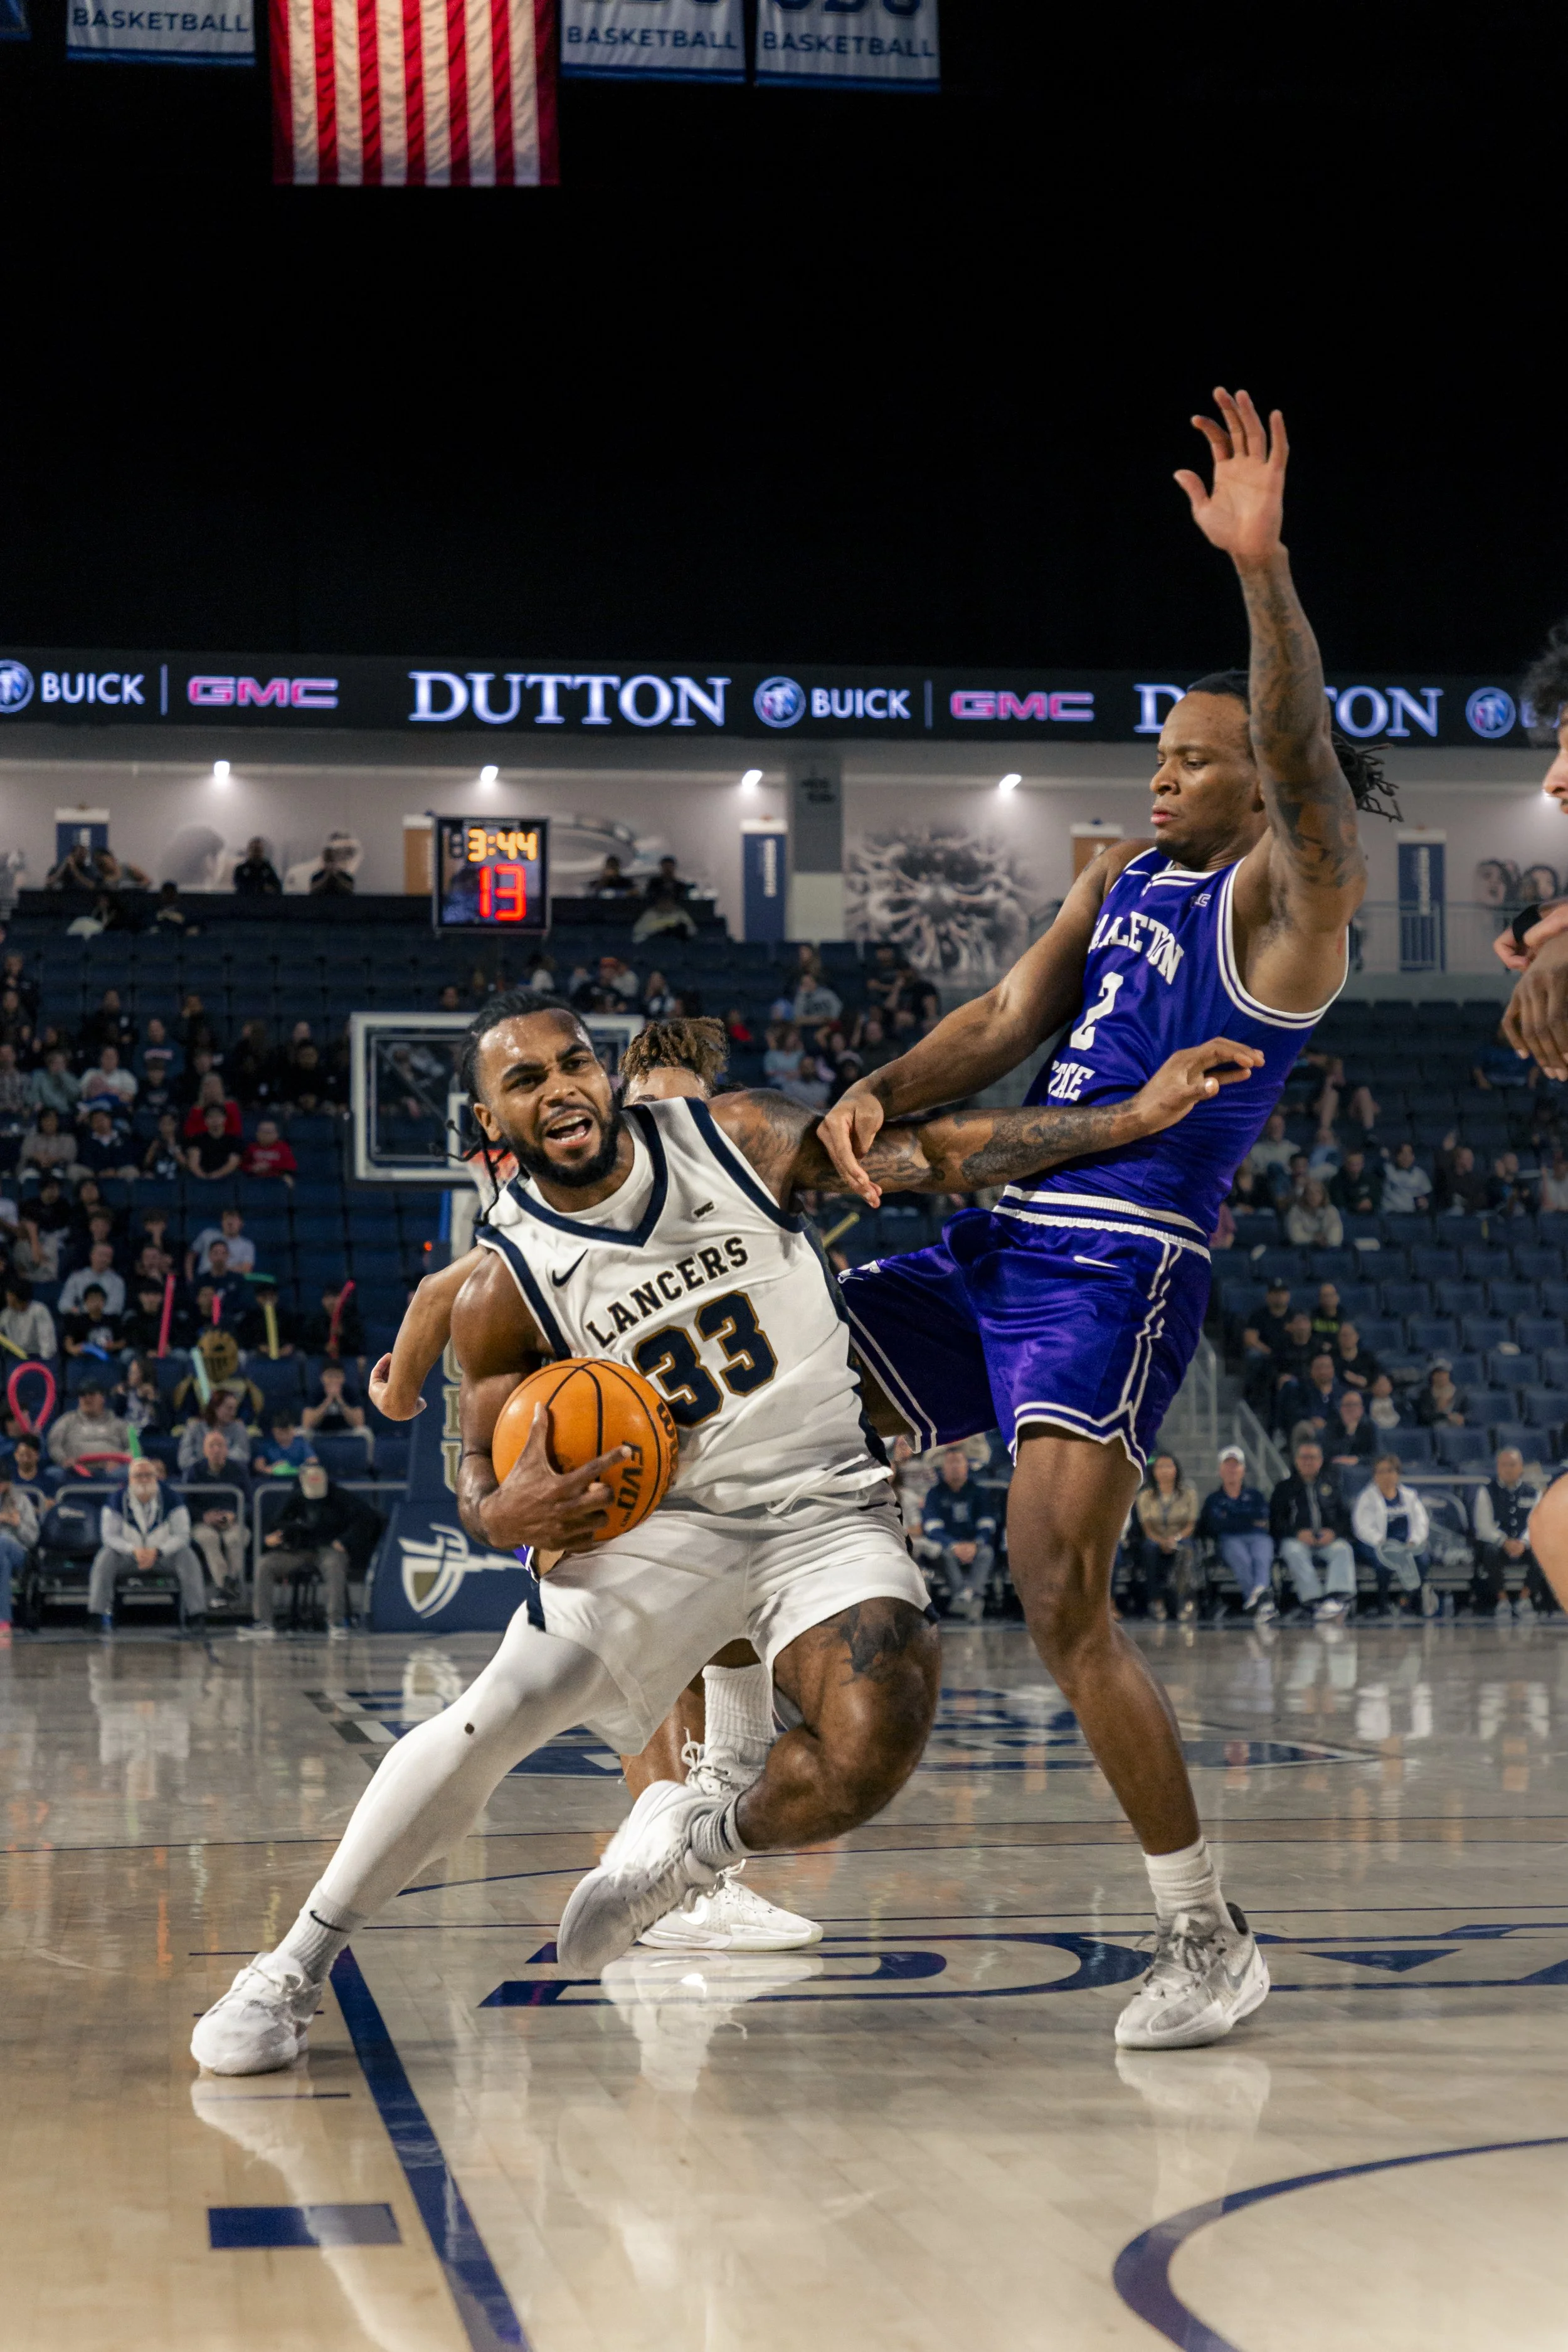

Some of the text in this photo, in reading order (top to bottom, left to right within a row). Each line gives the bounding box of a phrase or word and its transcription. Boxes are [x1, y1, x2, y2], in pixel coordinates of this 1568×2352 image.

[73, 9, 248, 33] BASKETBALL
[567, 26, 736, 50] BASKETBALL
[763, 31, 935, 57] BASKETBALL
[41, 672, 145, 705] BUICK
[188, 675, 339, 708] GMC
[408, 670, 731, 727] DUTTON
[811, 687, 911, 719] BUICK
[950, 691, 1094, 721] GMC
[467, 829, 538, 862] 3:44
[479, 863, 527, 921] 13
[1069, 972, 1123, 1051] 2
[585, 1236, 748, 1348] LANCERS
[632, 1290, 778, 1429] 33
